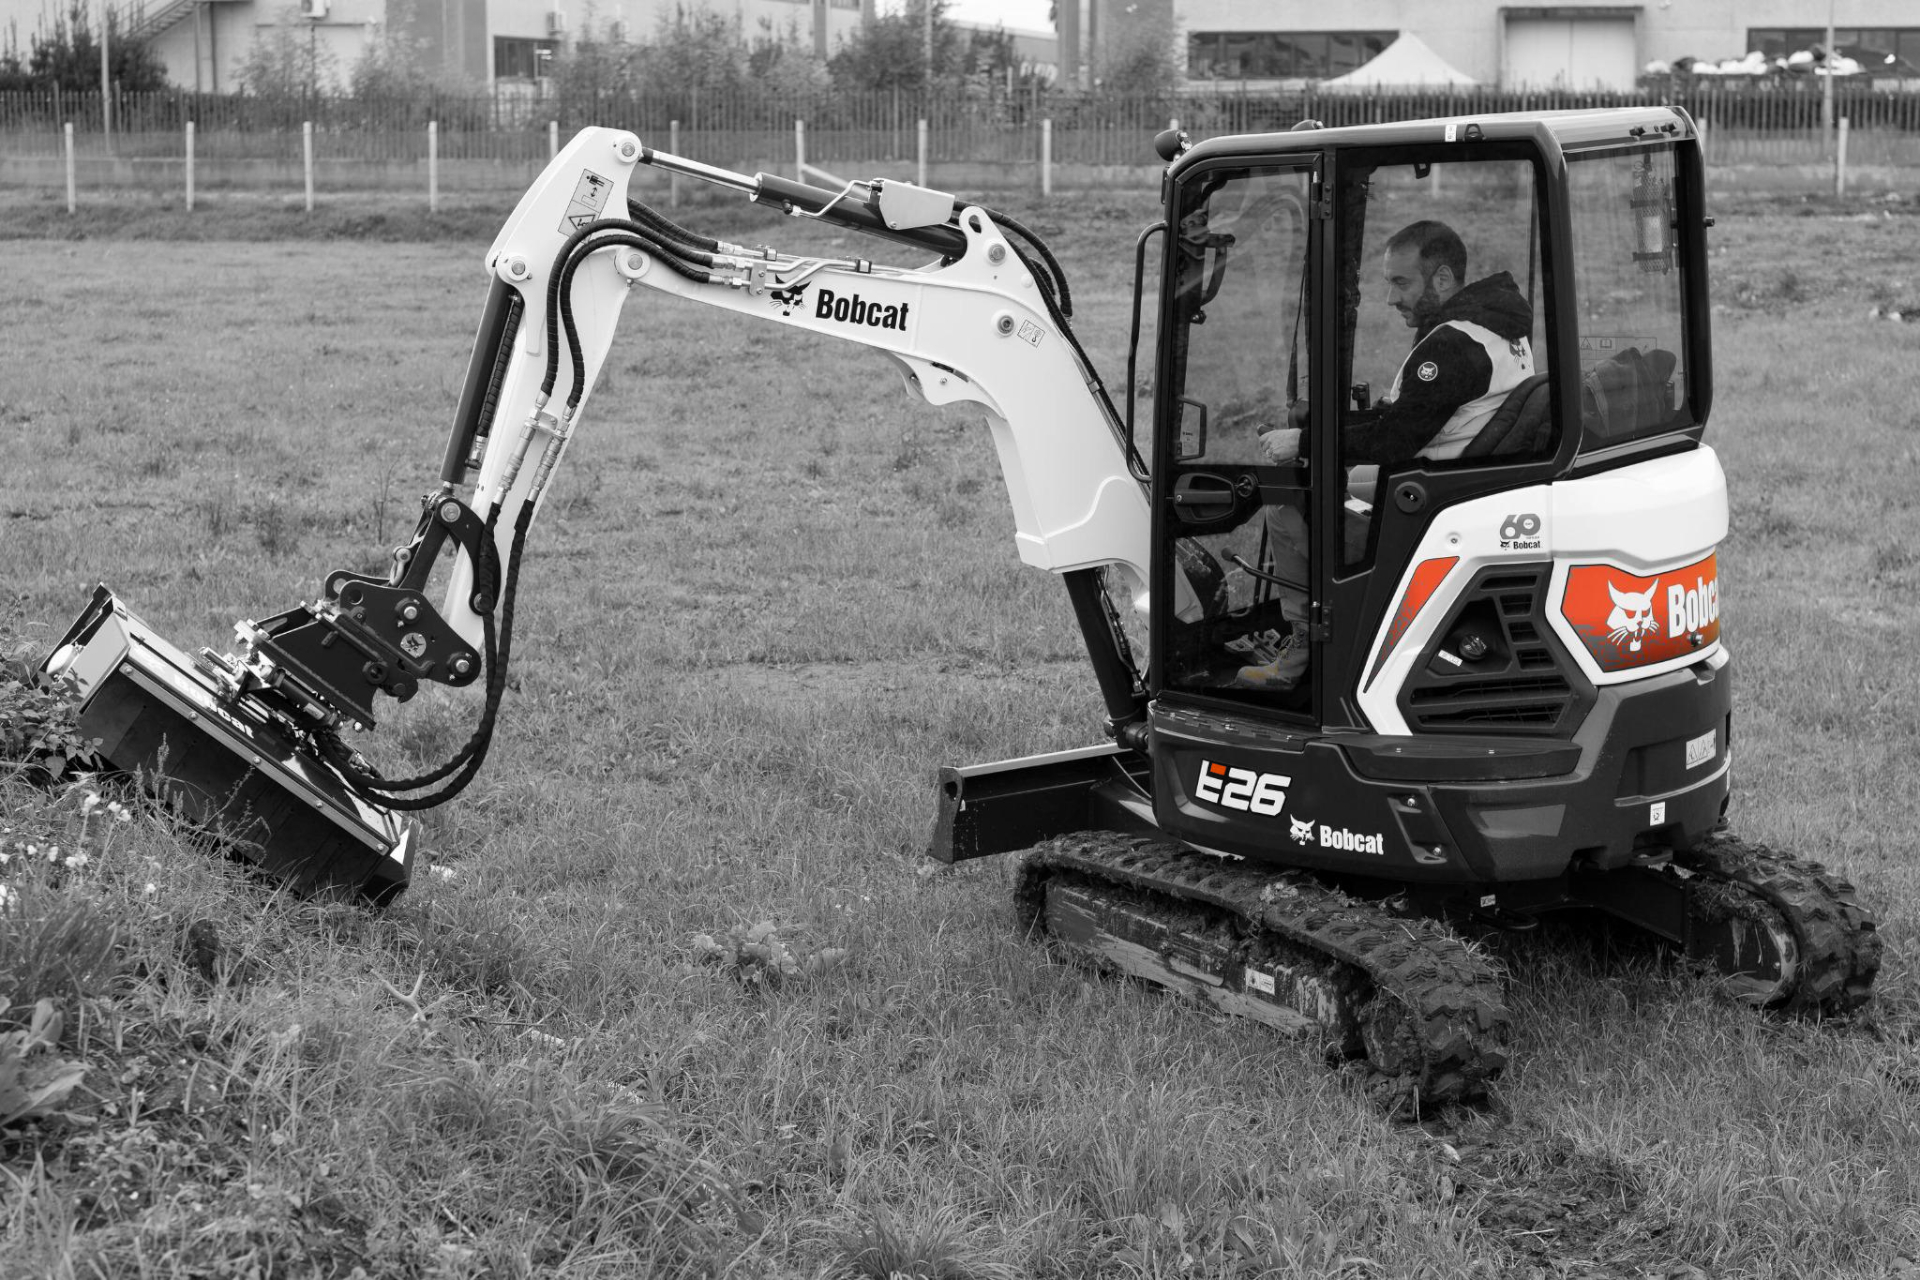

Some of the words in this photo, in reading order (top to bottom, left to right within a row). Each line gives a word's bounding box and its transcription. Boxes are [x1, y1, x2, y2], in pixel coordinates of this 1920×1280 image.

[816, 288, 909, 331] Bobcat
[1500, 513, 1541, 540] 60
[1513, 540, 1541, 550] Bobcat
[1195, 759, 1292, 817] E26
[1319, 824, 1385, 856] Bobcat
